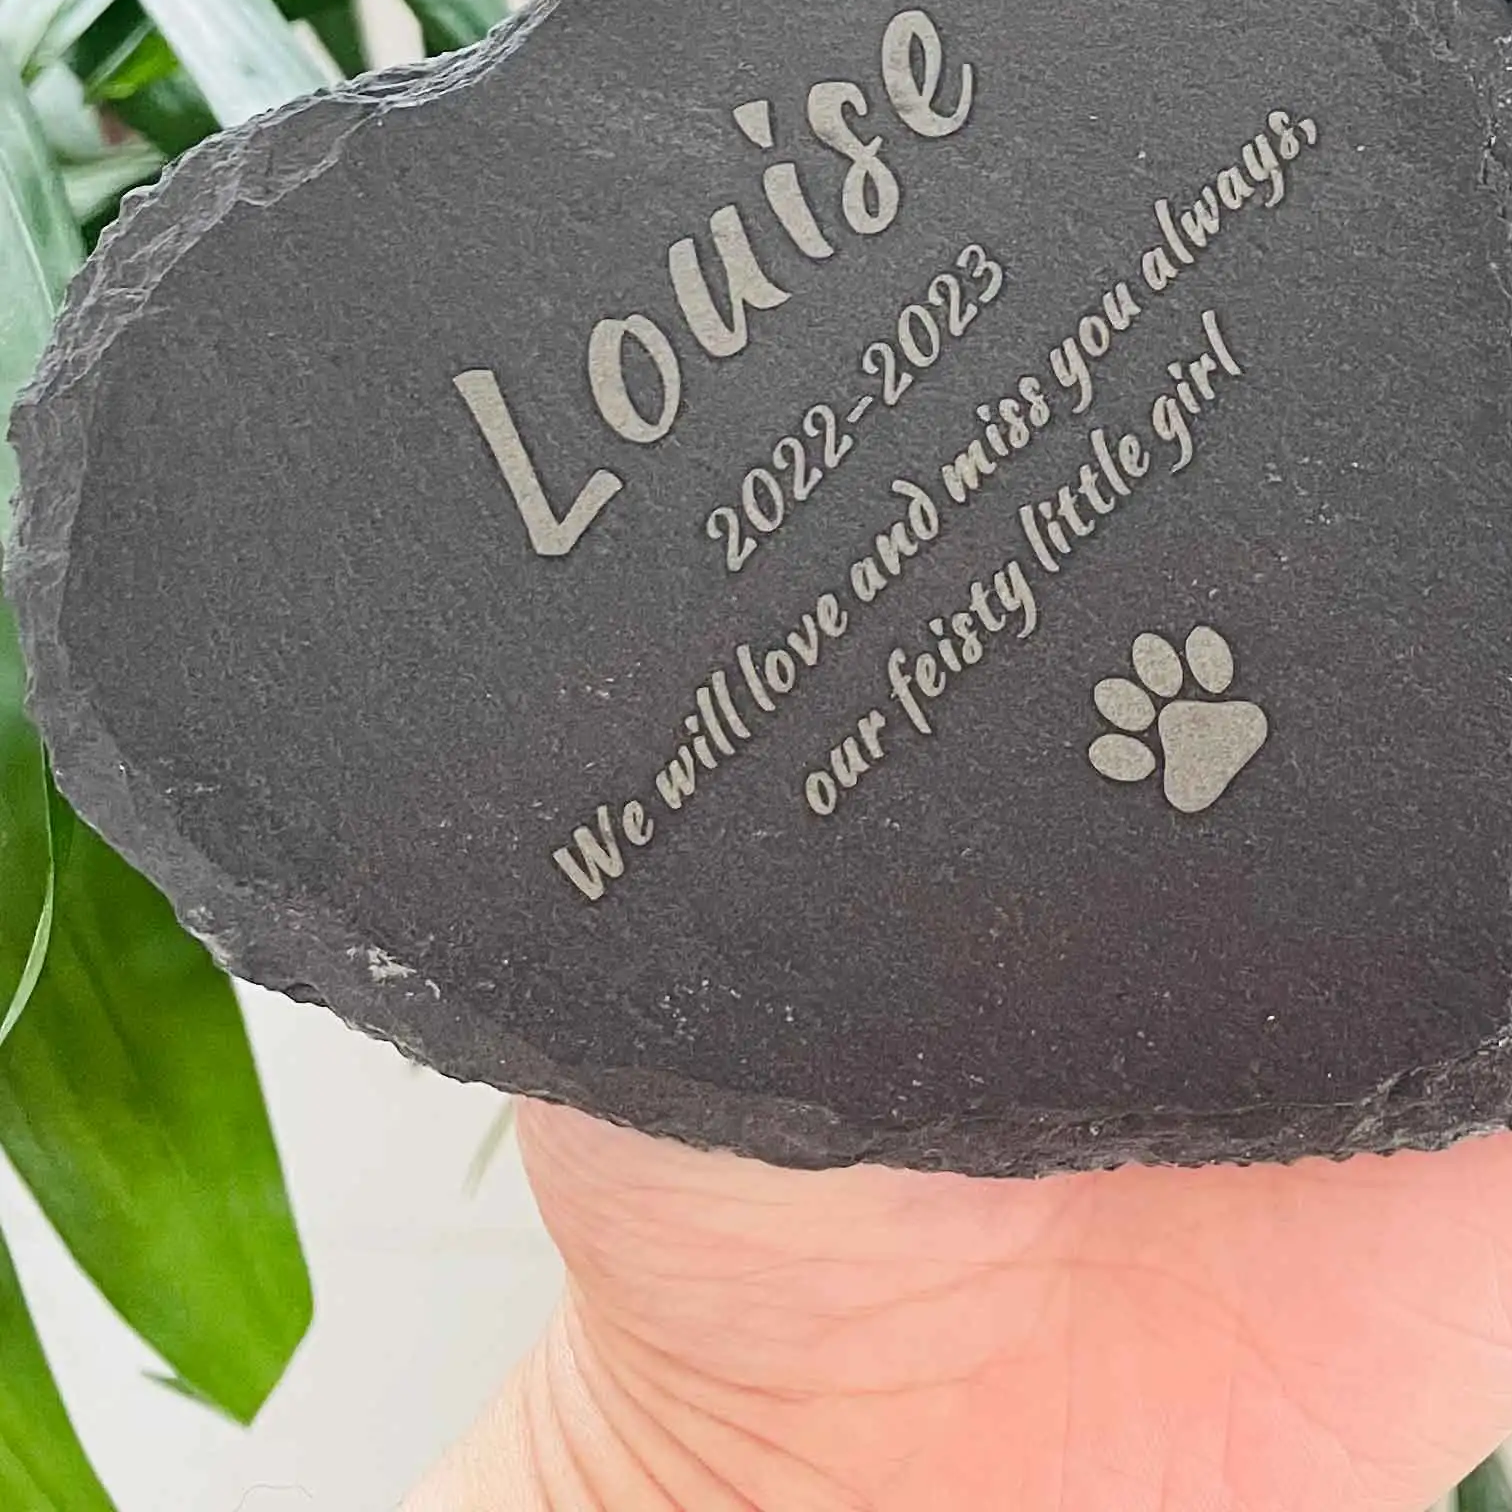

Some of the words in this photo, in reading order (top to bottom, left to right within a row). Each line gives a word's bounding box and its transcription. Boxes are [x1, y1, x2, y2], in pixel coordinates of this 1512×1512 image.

[453, 10, 973, 556] Louise
[554, 799, 653, 901] We
[656, 672, 750, 808] will
[737, 594, 848, 712] love
[851, 480, 939, 602] and
[943, 375, 1050, 502] miss
[1052, 280, 1141, 414] you
[1143, 111, 1317, 291] always,
[707, 243, 1003, 573] 2022-2023
[804, 709, 887, 816] our
[888, 561, 1038, 733] feisty
[1020, 427, 1149, 572] little
[1153, 311, 1244, 472] girl
